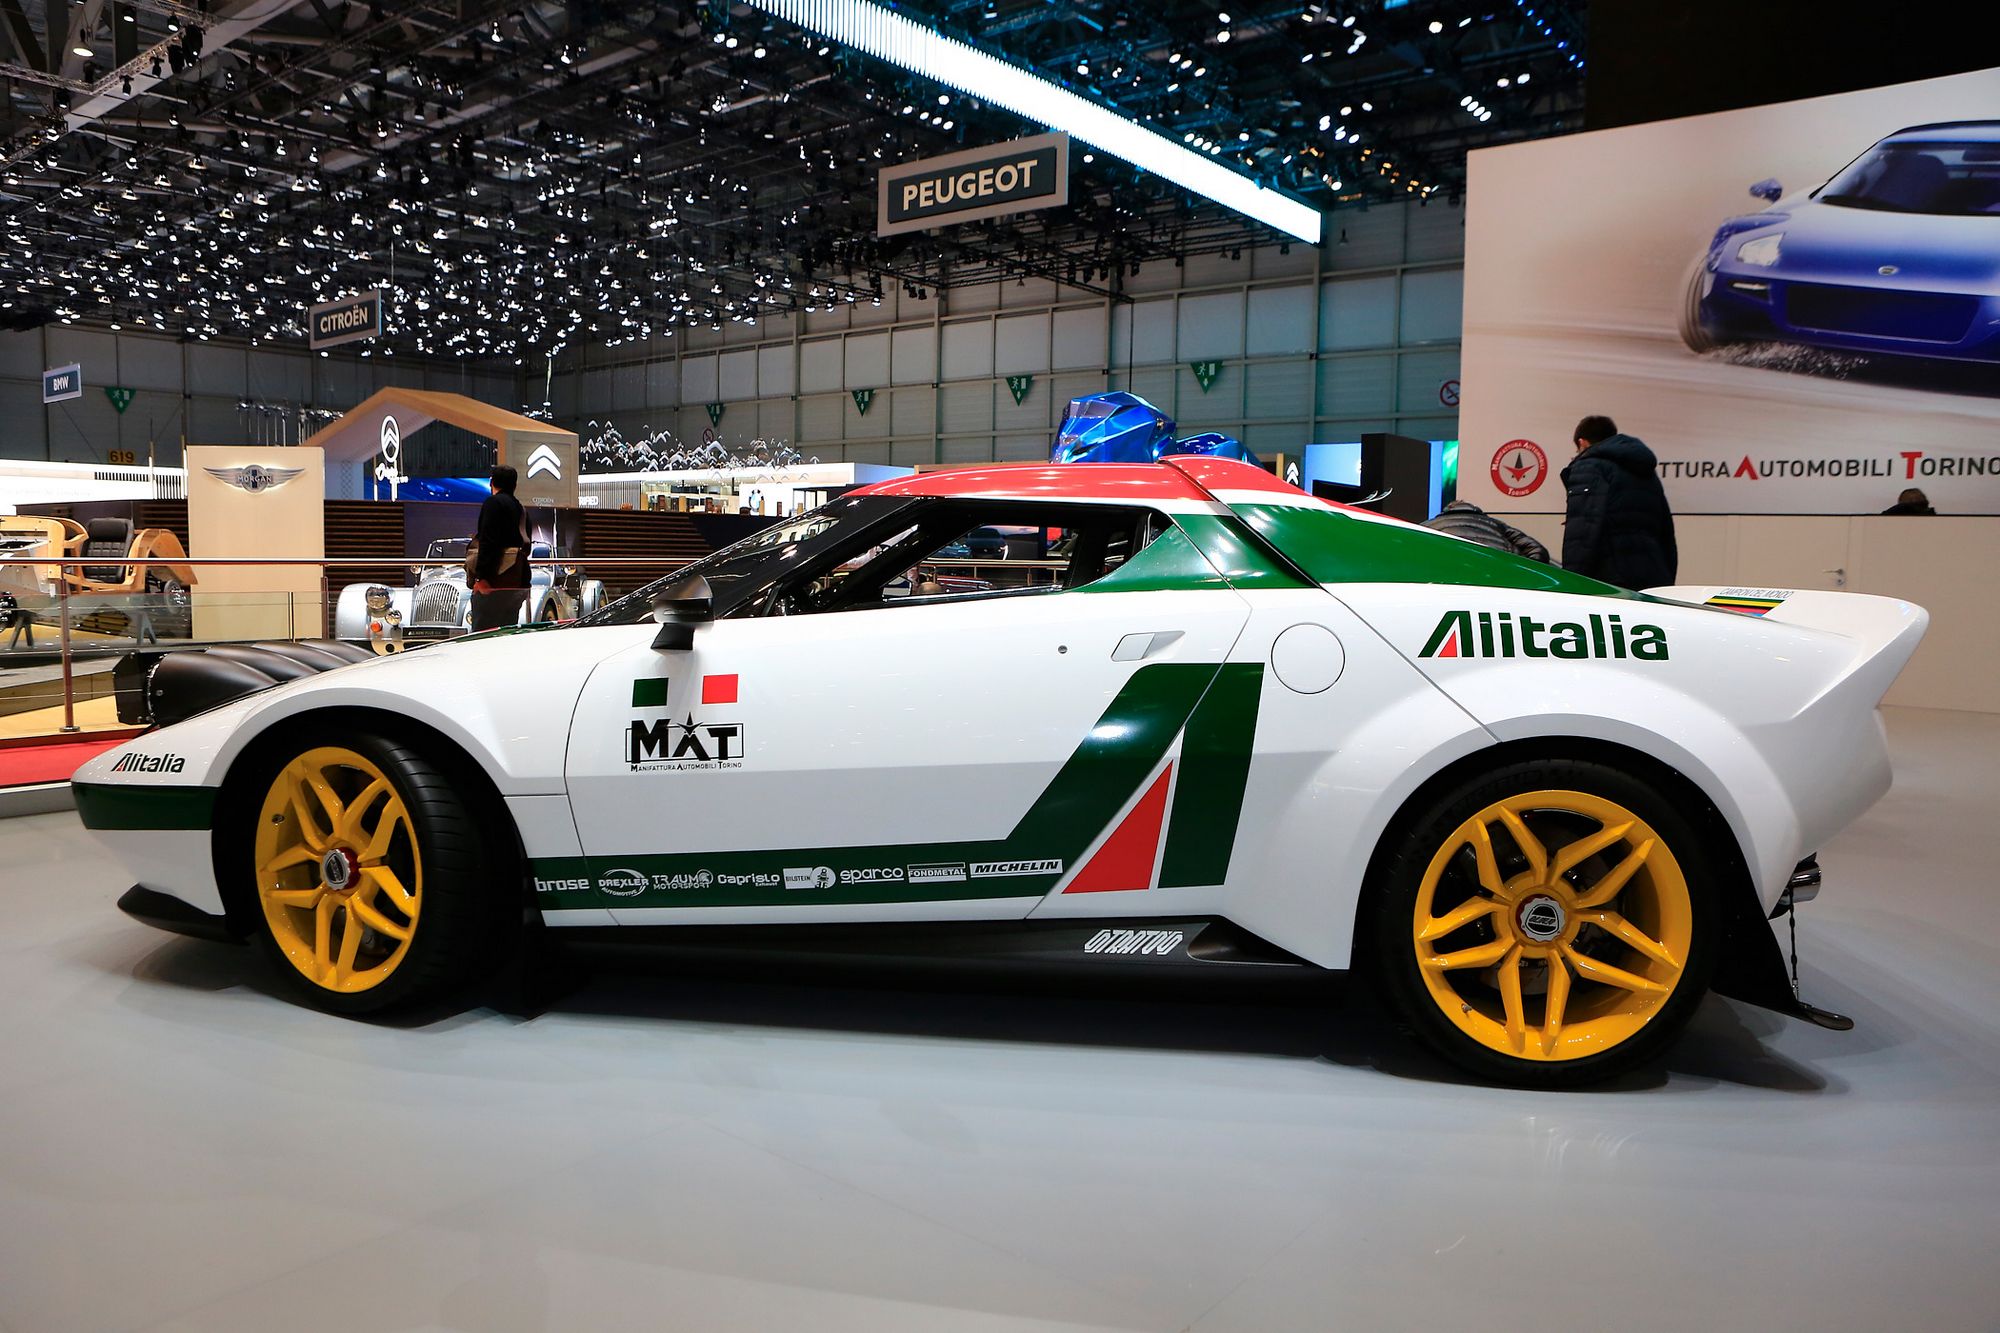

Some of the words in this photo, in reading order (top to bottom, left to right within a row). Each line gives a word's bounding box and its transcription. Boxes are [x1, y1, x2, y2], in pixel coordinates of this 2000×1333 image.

[903, 159, 1038, 211] PEUGEOT
[320, 305, 368, 334] CITROËN
[53, 375, 69, 391] BMW
[110, 451, 134, 463] 619
[1733, 455, 1893, 480] AUTOMOBILI
[1899, 451, 2000, 480] TORINO
[237, 475, 272, 483] MORGAN
[1418, 610, 1670, 661] Alitalia
[631, 717, 738, 764] MAT
[110, 753, 186, 773] Alitalia
[631, 764, 676, 773] MANIFATTURA
[676, 763, 717, 771] AUTOMOBILI
[717, 761, 742, 769] TORINO
[908, 868, 967, 878] FONDMETAL
[975, 861, 1059, 874] MICHELIN
[652, 874, 699, 884] TRAUM
[840, 867, 904, 885] sparco
[533, 877, 590, 892] brose
[598, 879, 649, 889] DREXLER
[601, 886, 638, 897] AUTOMOTIVE
[653, 882, 710, 890] MOTORSPORT
[1084, 929, 1183, 955] STRATOS
